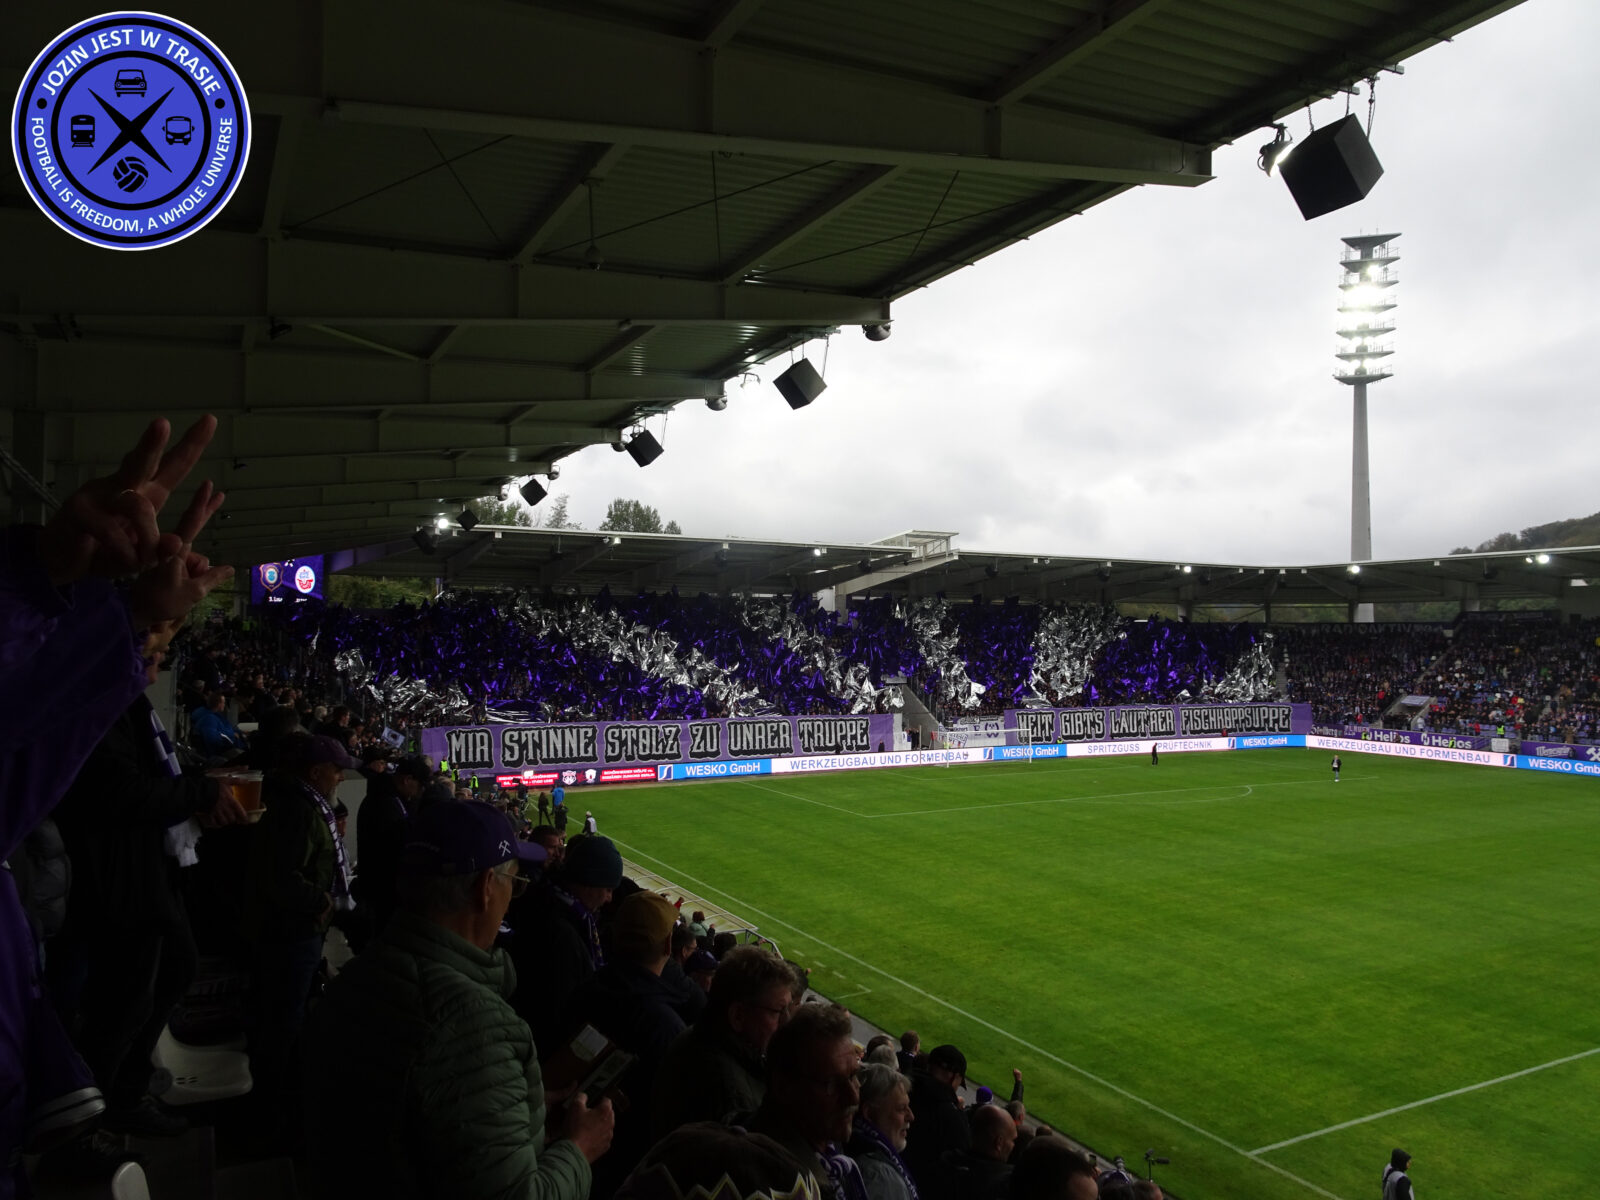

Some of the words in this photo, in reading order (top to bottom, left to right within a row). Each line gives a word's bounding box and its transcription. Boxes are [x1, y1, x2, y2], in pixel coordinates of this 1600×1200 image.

[446, 729, 494, 768] MIR
[502, 725, 598, 767] STINNE
[605, 724, 682, 762] STOLZ
[689, 722, 721, 758] ZU
[798, 718, 870, 752] TRUPPE
[1088, 744, 1140, 753] SPRITZGUSS
[1157, 741, 1212, 751] PRÜFTECHNIK
[1243, 738, 1267, 746] WESKO
[1268, 737, 1288, 745] GmbH
[1432, 736, 1472, 749] Heios
[1002, 748, 1033, 758] WESKO
[1035, 747, 1059, 756] GmbH
[1317, 739, 1391, 753] WERKZEUGBAU
[1395, 747, 1416, 756] UND
[1420, 748, 1490, 764] FORMENBAU
[790, 756, 876, 770] WERKZEUGBAU
[880, 754, 902, 765] UND
[905, 750, 969, 763] FORMENBAU
[1528, 758, 1572, 771] WESKO
[686, 764, 727, 776] WESKO
[732, 762, 761, 774] GmbH
